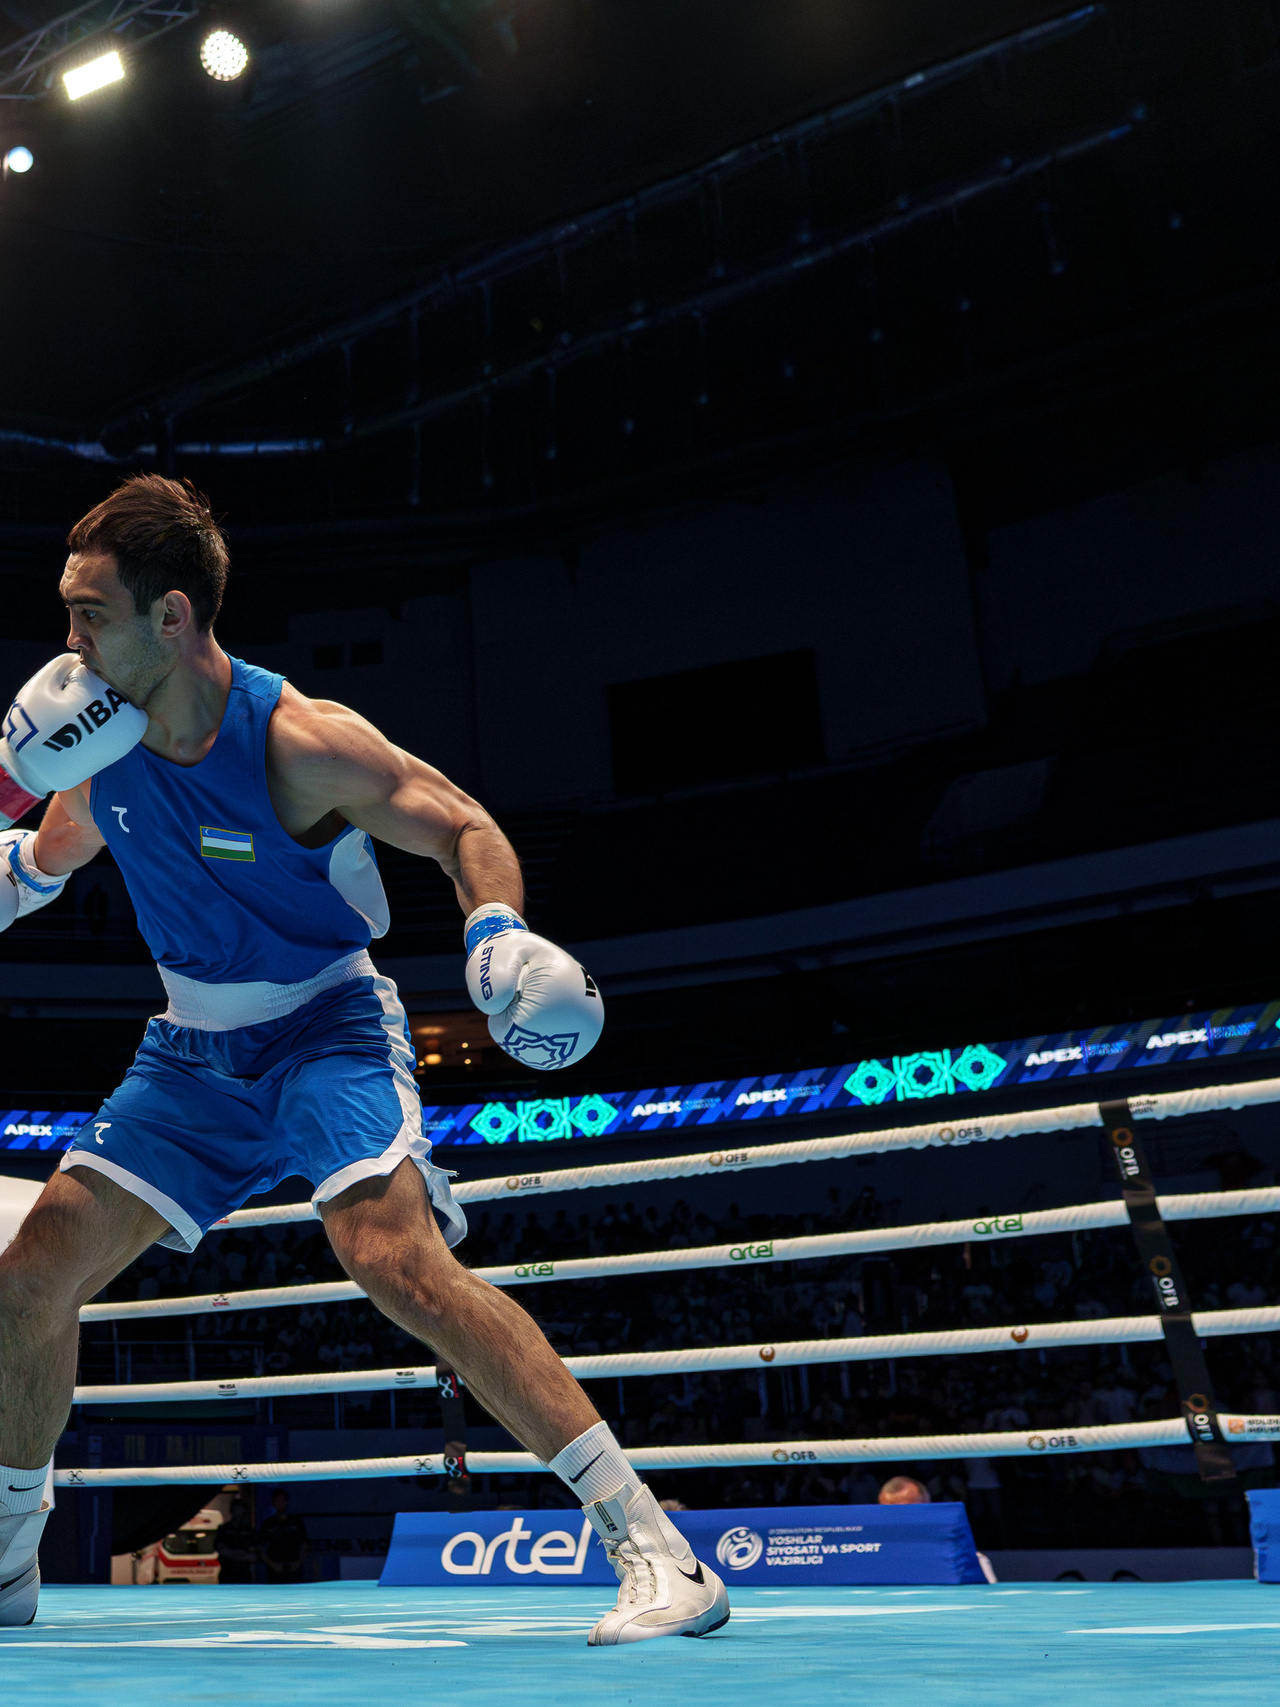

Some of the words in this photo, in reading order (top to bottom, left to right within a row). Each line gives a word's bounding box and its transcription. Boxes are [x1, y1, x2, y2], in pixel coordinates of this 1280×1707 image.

[77, 687, 129, 736] IBA
[479, 945, 494, 1002] STING
[1145, 1027, 1209, 1049] APEX
[1024, 1046, 1084, 1067] APEX
[735, 1087, 788, 1106] APEX
[631, 1100, 682, 1118] APEX
[4, 1124, 53, 1137] APEX
[958, 1126, 983, 1138] OFB
[725, 1153, 748, 1163] OFB
[1120, 1147, 1140, 1176] OFB
[520, 1175, 541, 1186] OFB
[973, 1214, 1024, 1235] artel
[729, 1241, 774, 1261] artel
[515, 1262, 555, 1278] artel
[1158, 1276, 1180, 1308] OFB
[1048, 1435, 1077, 1449] OFB
[791, 1450, 817, 1462] OFB
[441, 1517, 591, 1575] artel
[766, 1545, 819, 1556] SIYOSATI
[821, 1545, 839, 1554] VA
[840, 1543, 882, 1553] SPORT
[768, 1535, 823, 1546] YOSHLAR
[765, 1556, 823, 1566] VAZIRLIGI
